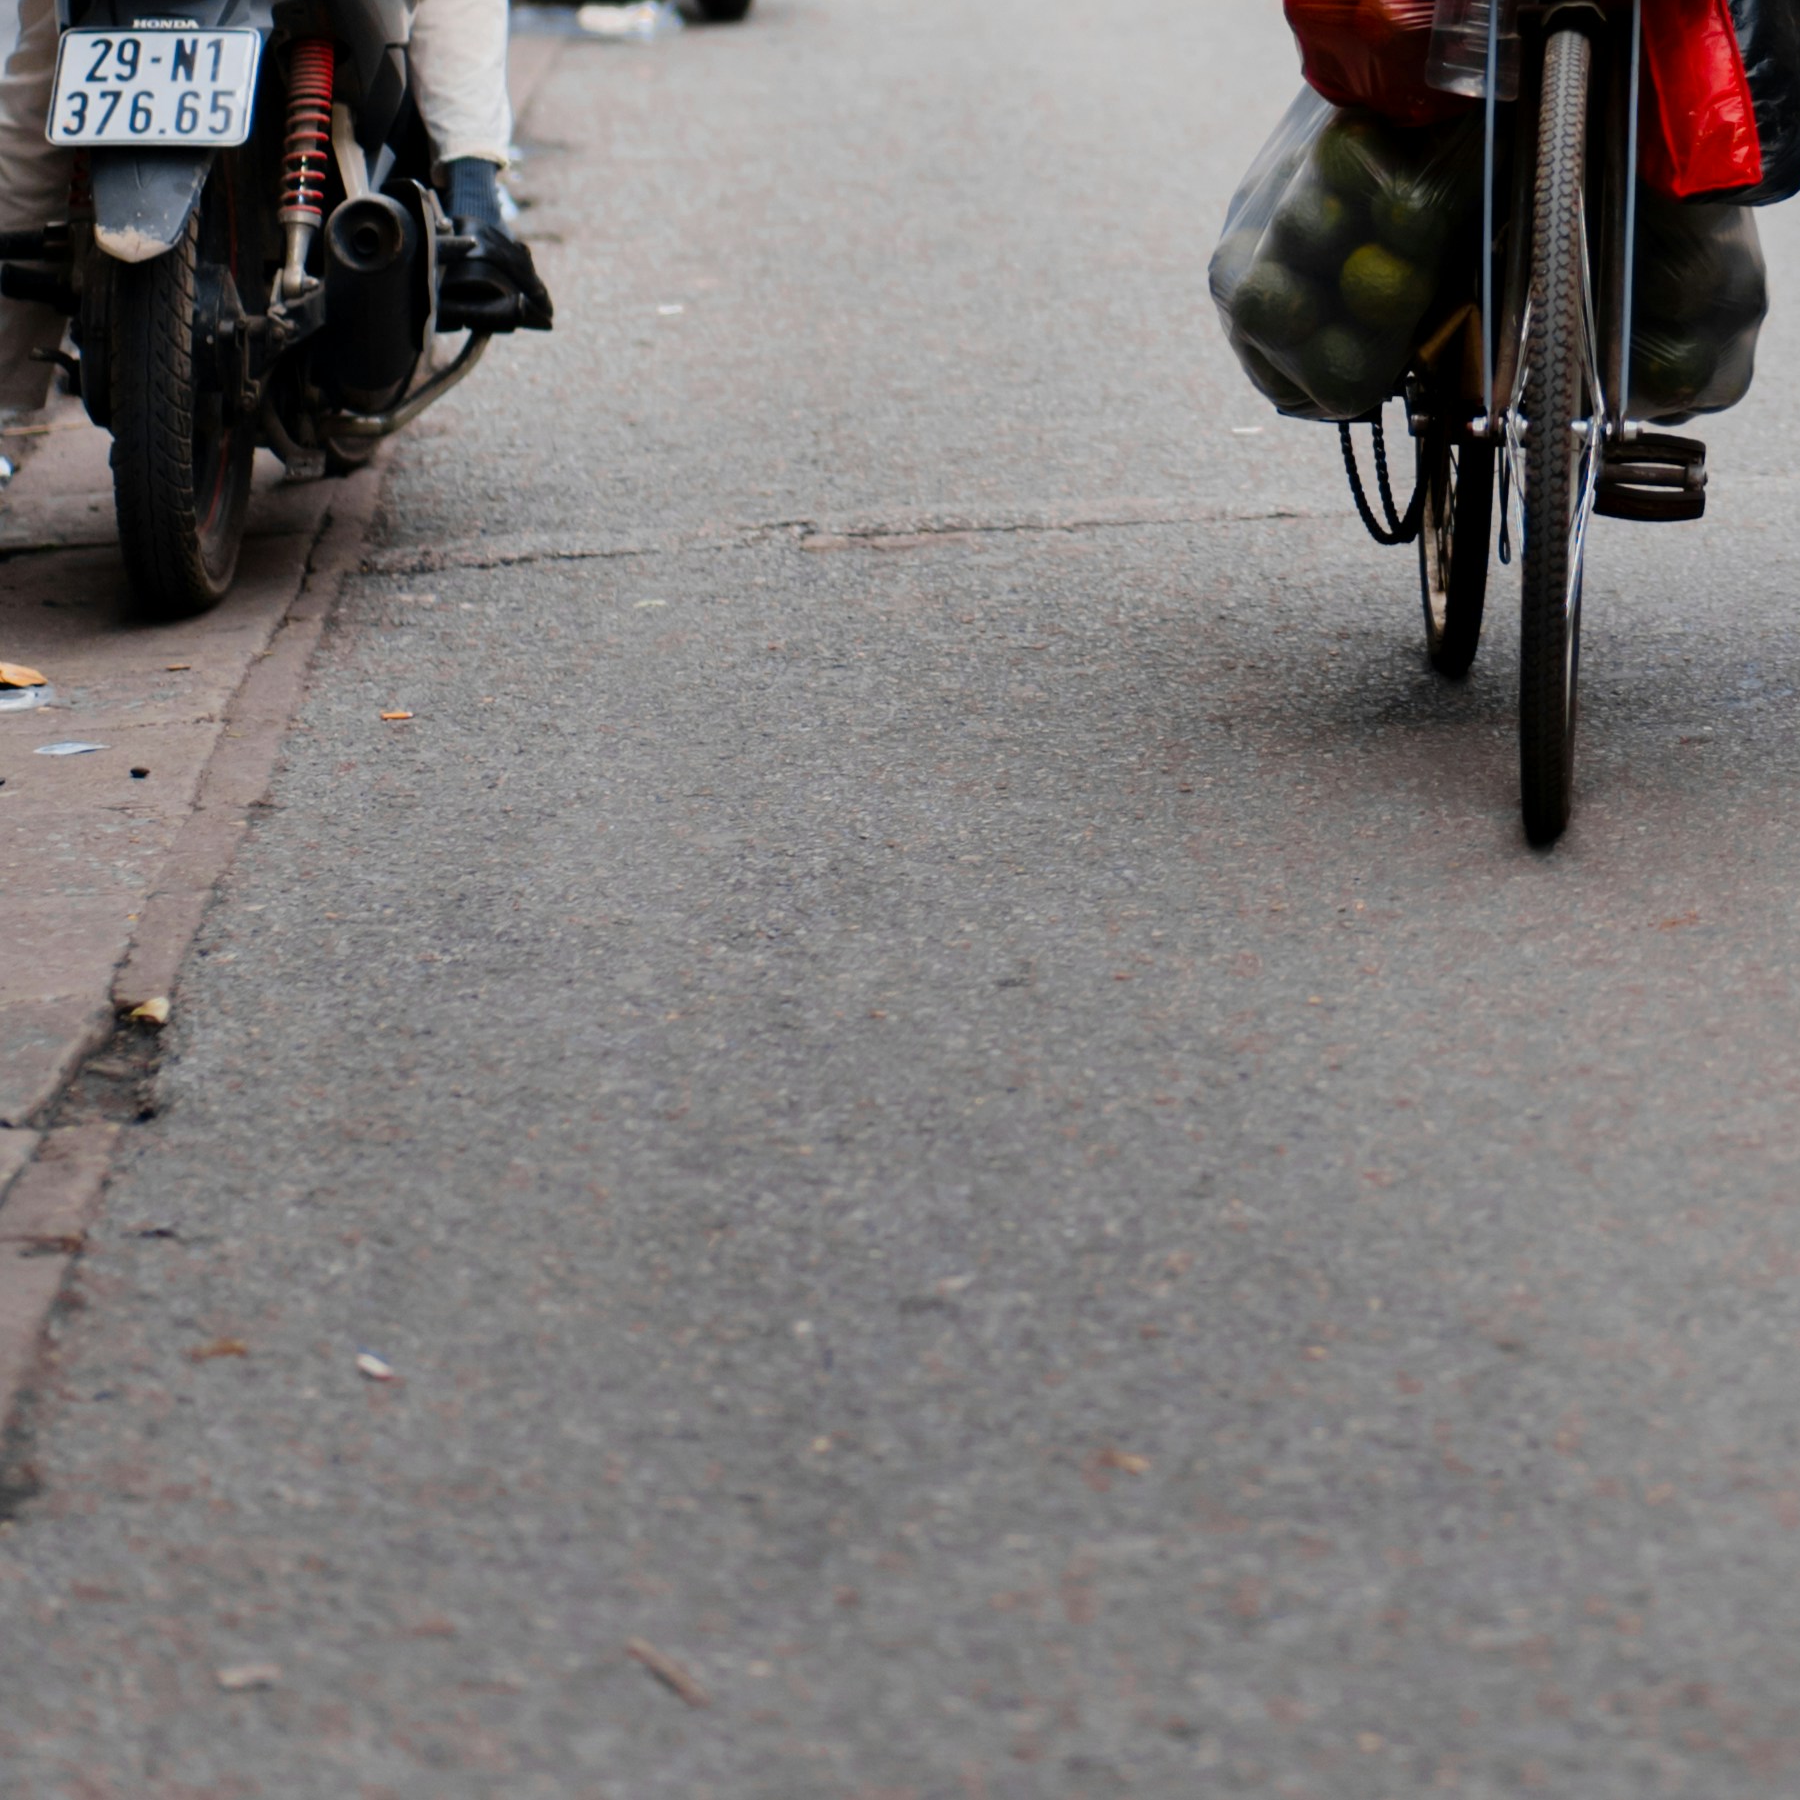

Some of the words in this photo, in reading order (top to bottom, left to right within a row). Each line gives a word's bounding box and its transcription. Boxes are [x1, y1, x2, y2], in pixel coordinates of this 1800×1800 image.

[132, 18, 199, 29] HONDA
[85, 38, 224, 82] 29-N1
[62, 90, 236, 136] 376.65
